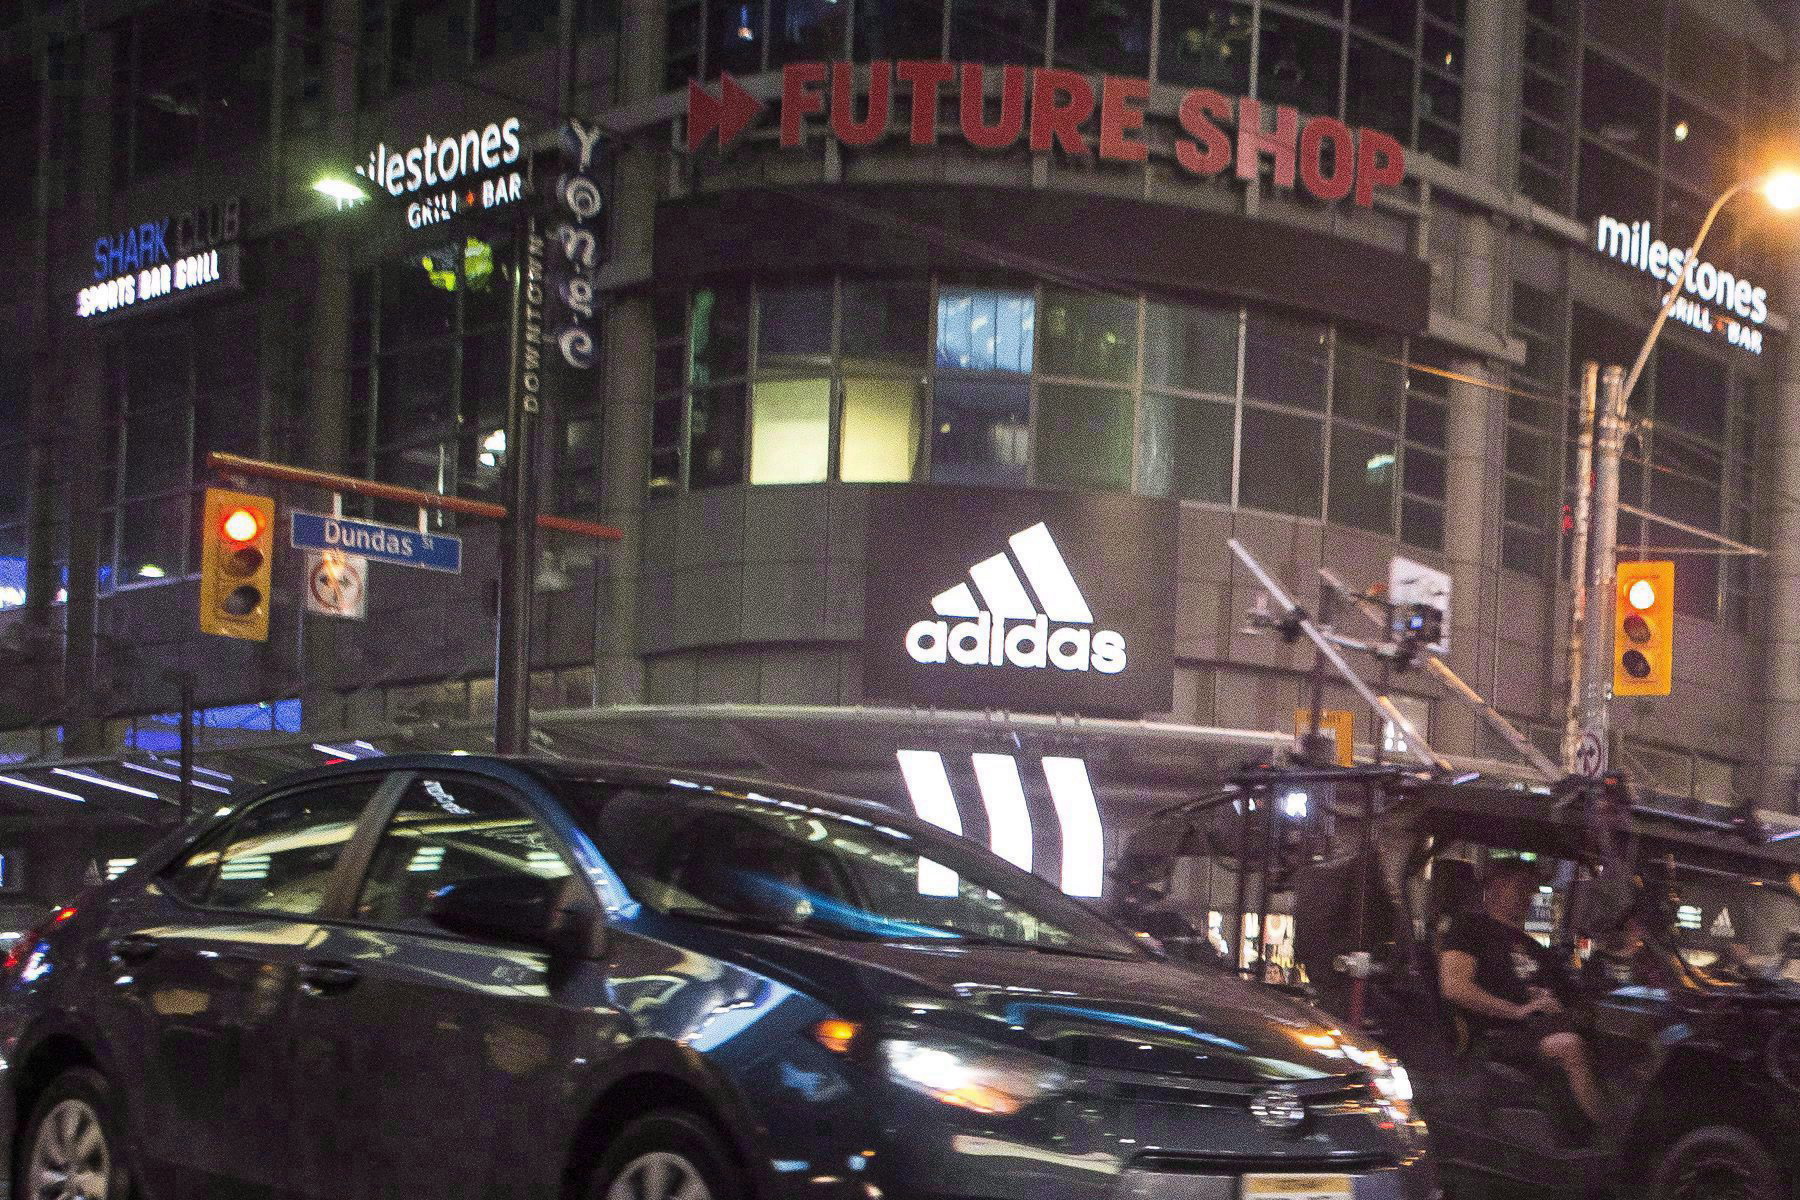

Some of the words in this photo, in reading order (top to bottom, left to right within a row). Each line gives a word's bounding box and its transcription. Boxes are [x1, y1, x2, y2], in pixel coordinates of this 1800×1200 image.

[340, 117, 520, 206] ilestones
[780, 60, 1154, 163] FUTURE
[1176, 88, 1405, 208] SHOP
[483, 173, 521, 210] BAR
[93, 215, 170, 281] SHARK
[174, 249, 220, 289] GRILL
[1598, 215, 1768, 324] milestones
[324, 519, 414, 557] Dundas
[905, 610, 1127, 674] adidas
